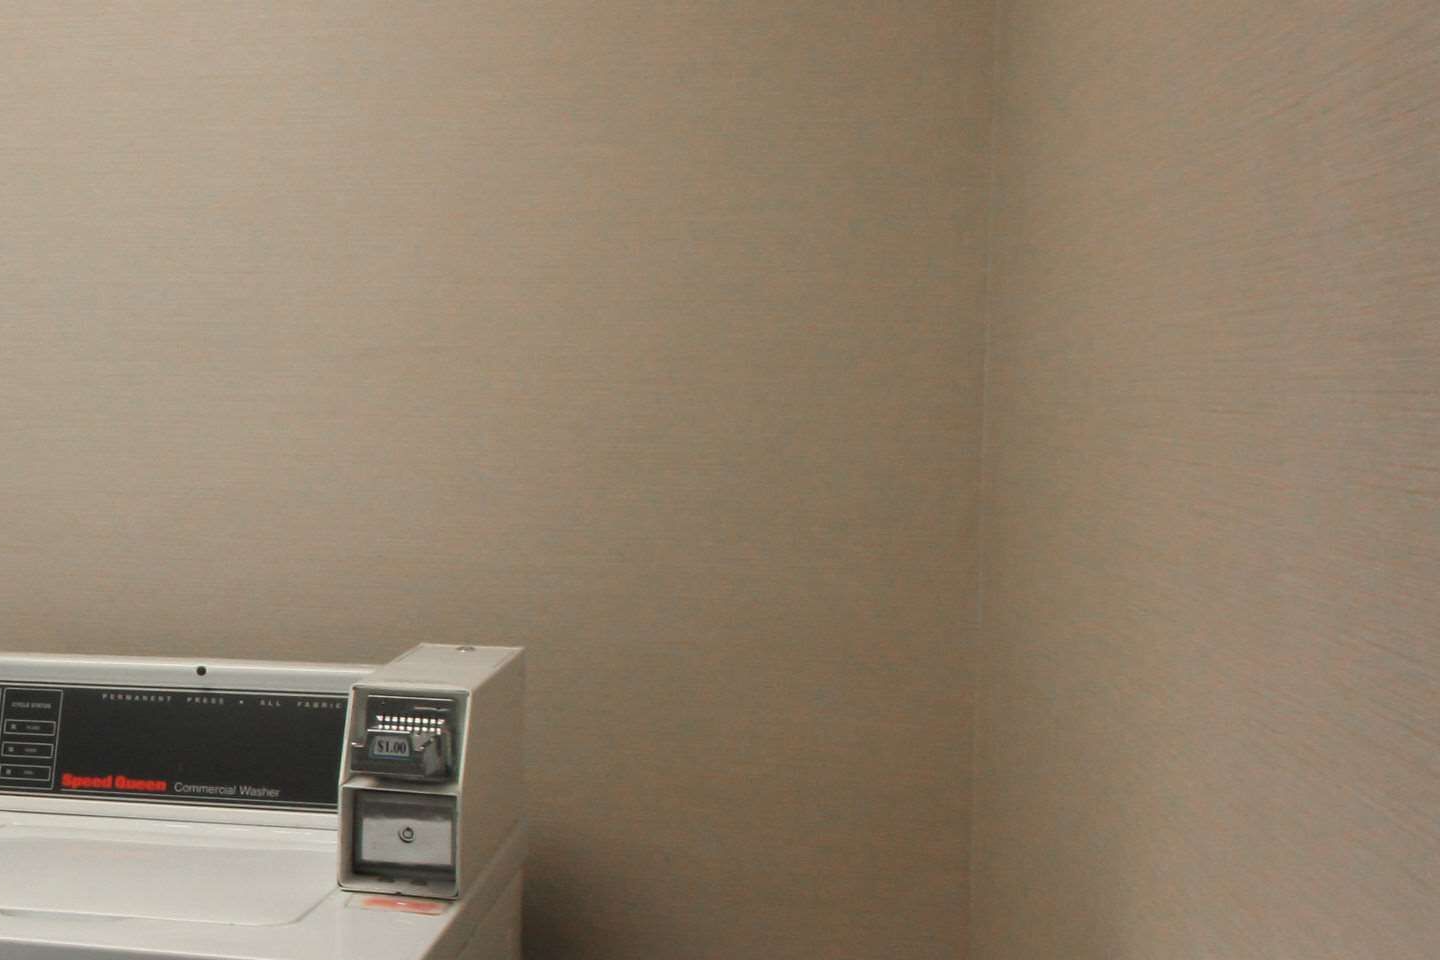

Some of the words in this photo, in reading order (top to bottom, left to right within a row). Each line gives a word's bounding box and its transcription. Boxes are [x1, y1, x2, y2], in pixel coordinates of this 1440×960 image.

[101, 692, 172, 703] PERMANENT
[186, 696, 225, 706] PRESS
[377, 739, 407, 754] $1.00
[61, 771, 113, 790] Speed
[114, 774, 169, 793] Queen
[173, 780, 238, 796] Commercial
[239, 783, 281, 799] Washer
